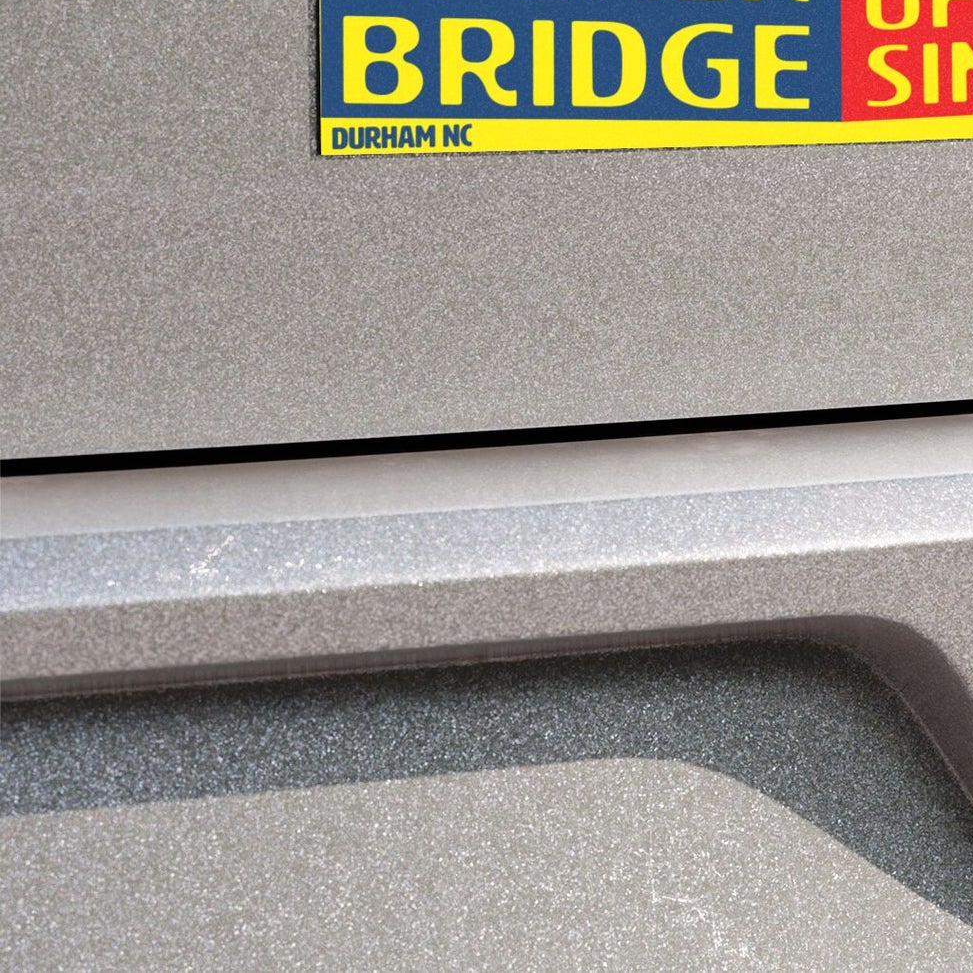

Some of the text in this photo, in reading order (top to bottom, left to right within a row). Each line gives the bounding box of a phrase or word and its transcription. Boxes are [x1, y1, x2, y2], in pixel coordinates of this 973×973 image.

[342, 15, 810, 110] BRIDGE
[332, 124, 473, 150] DURHAM NC
